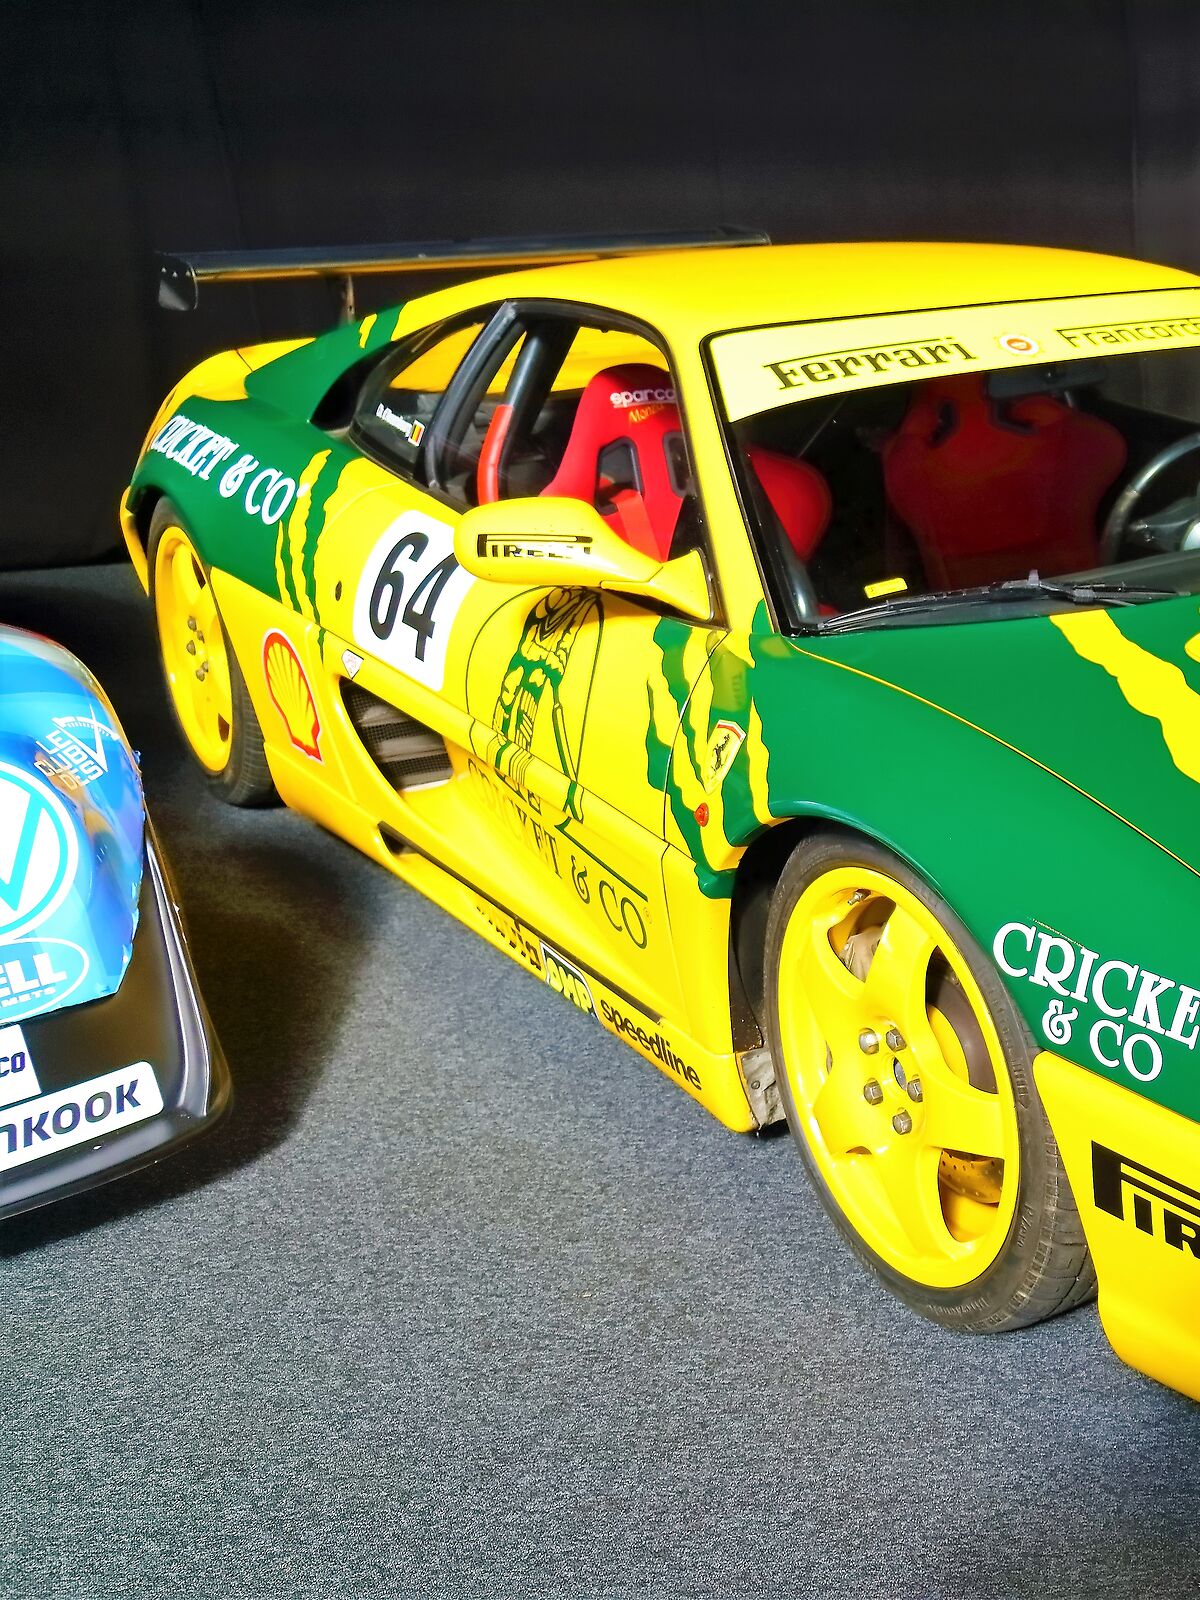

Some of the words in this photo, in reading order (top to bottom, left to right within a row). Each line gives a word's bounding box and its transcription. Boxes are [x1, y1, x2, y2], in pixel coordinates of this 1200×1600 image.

[609, 388, 676, 408] sparco
[763, 336, 977, 390] Ferrari
[219, 454, 260, 498] &
[245, 468, 296, 525] CO
[369, 532, 460, 662] 64
[571, 854, 591, 905] &
[599, 880, 648, 950] CO
[545, 956, 594, 1015] OMP
[600, 999, 702, 1091] speedline
[1041, 998, 1080, 1045] &
[1088, 1019, 1164, 1082] CO
